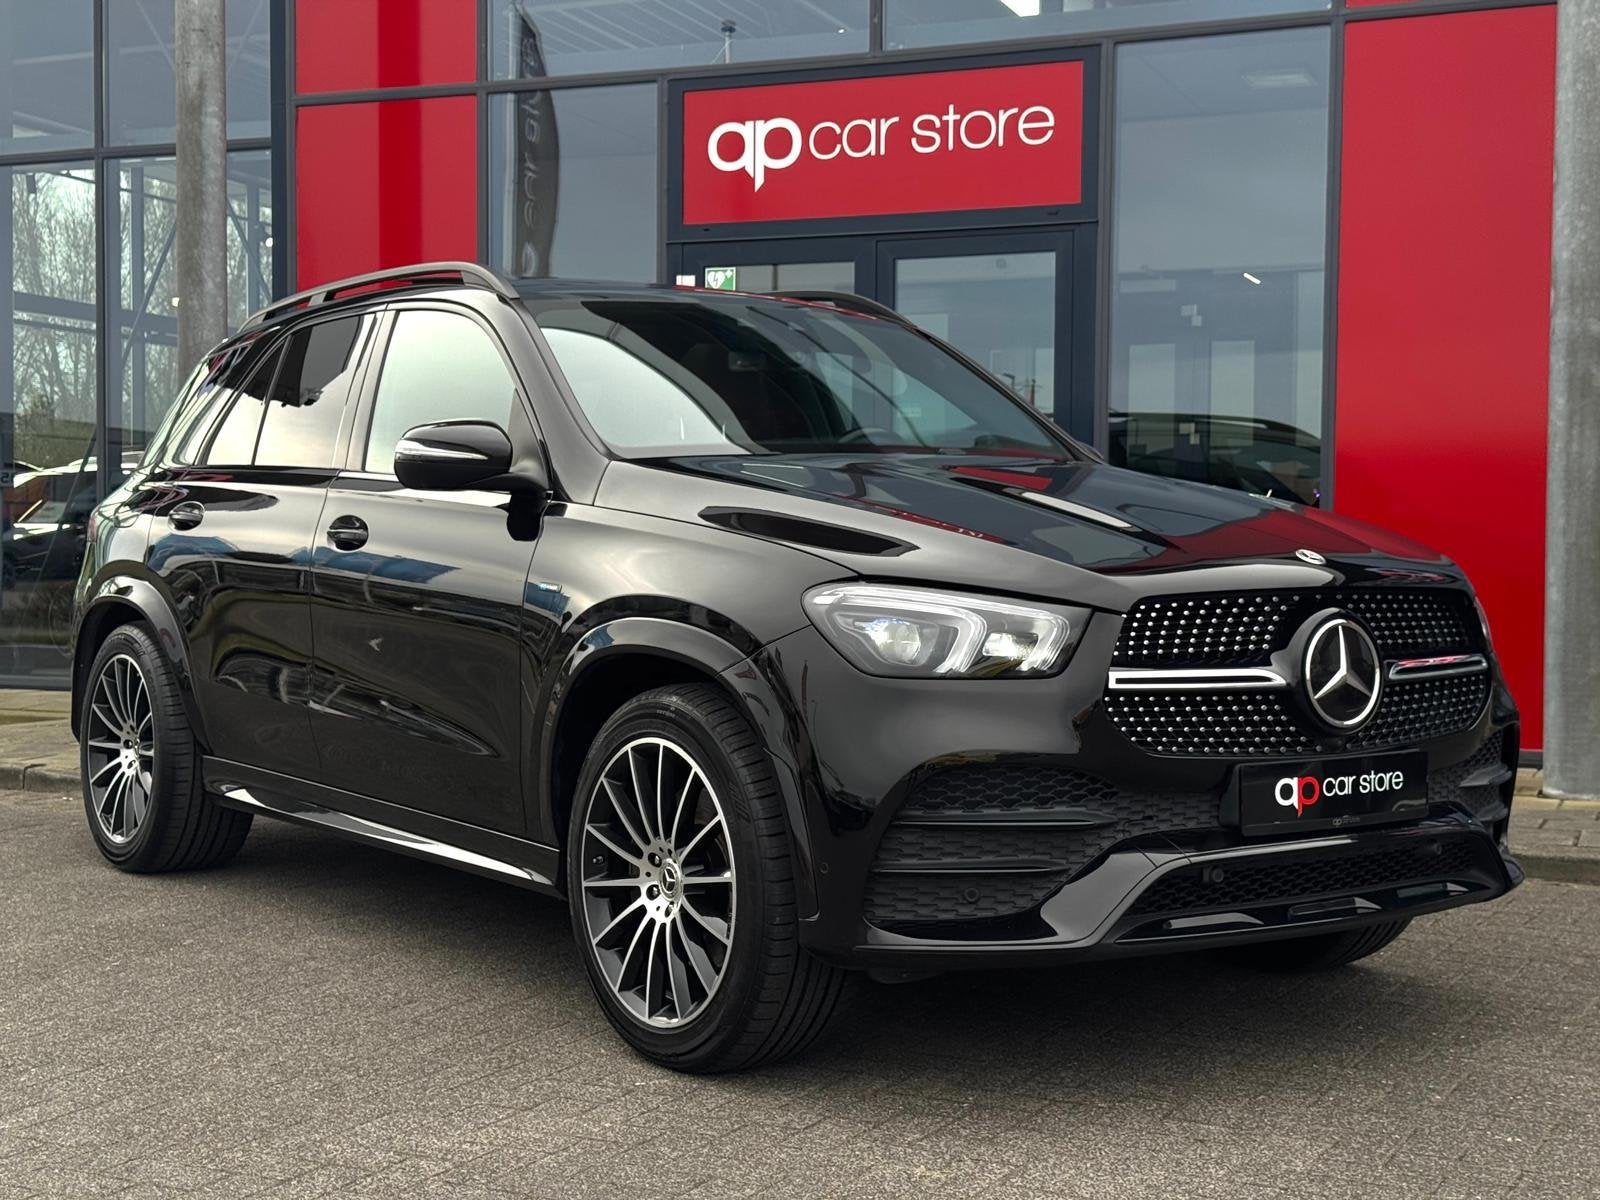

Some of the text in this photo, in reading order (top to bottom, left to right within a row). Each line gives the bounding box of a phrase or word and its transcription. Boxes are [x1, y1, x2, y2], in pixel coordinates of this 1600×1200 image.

[808, 116, 900, 161] car
[910, 103, 1055, 154] store
[1322, 774, 1357, 797] car
[1358, 769, 1405, 794] store
